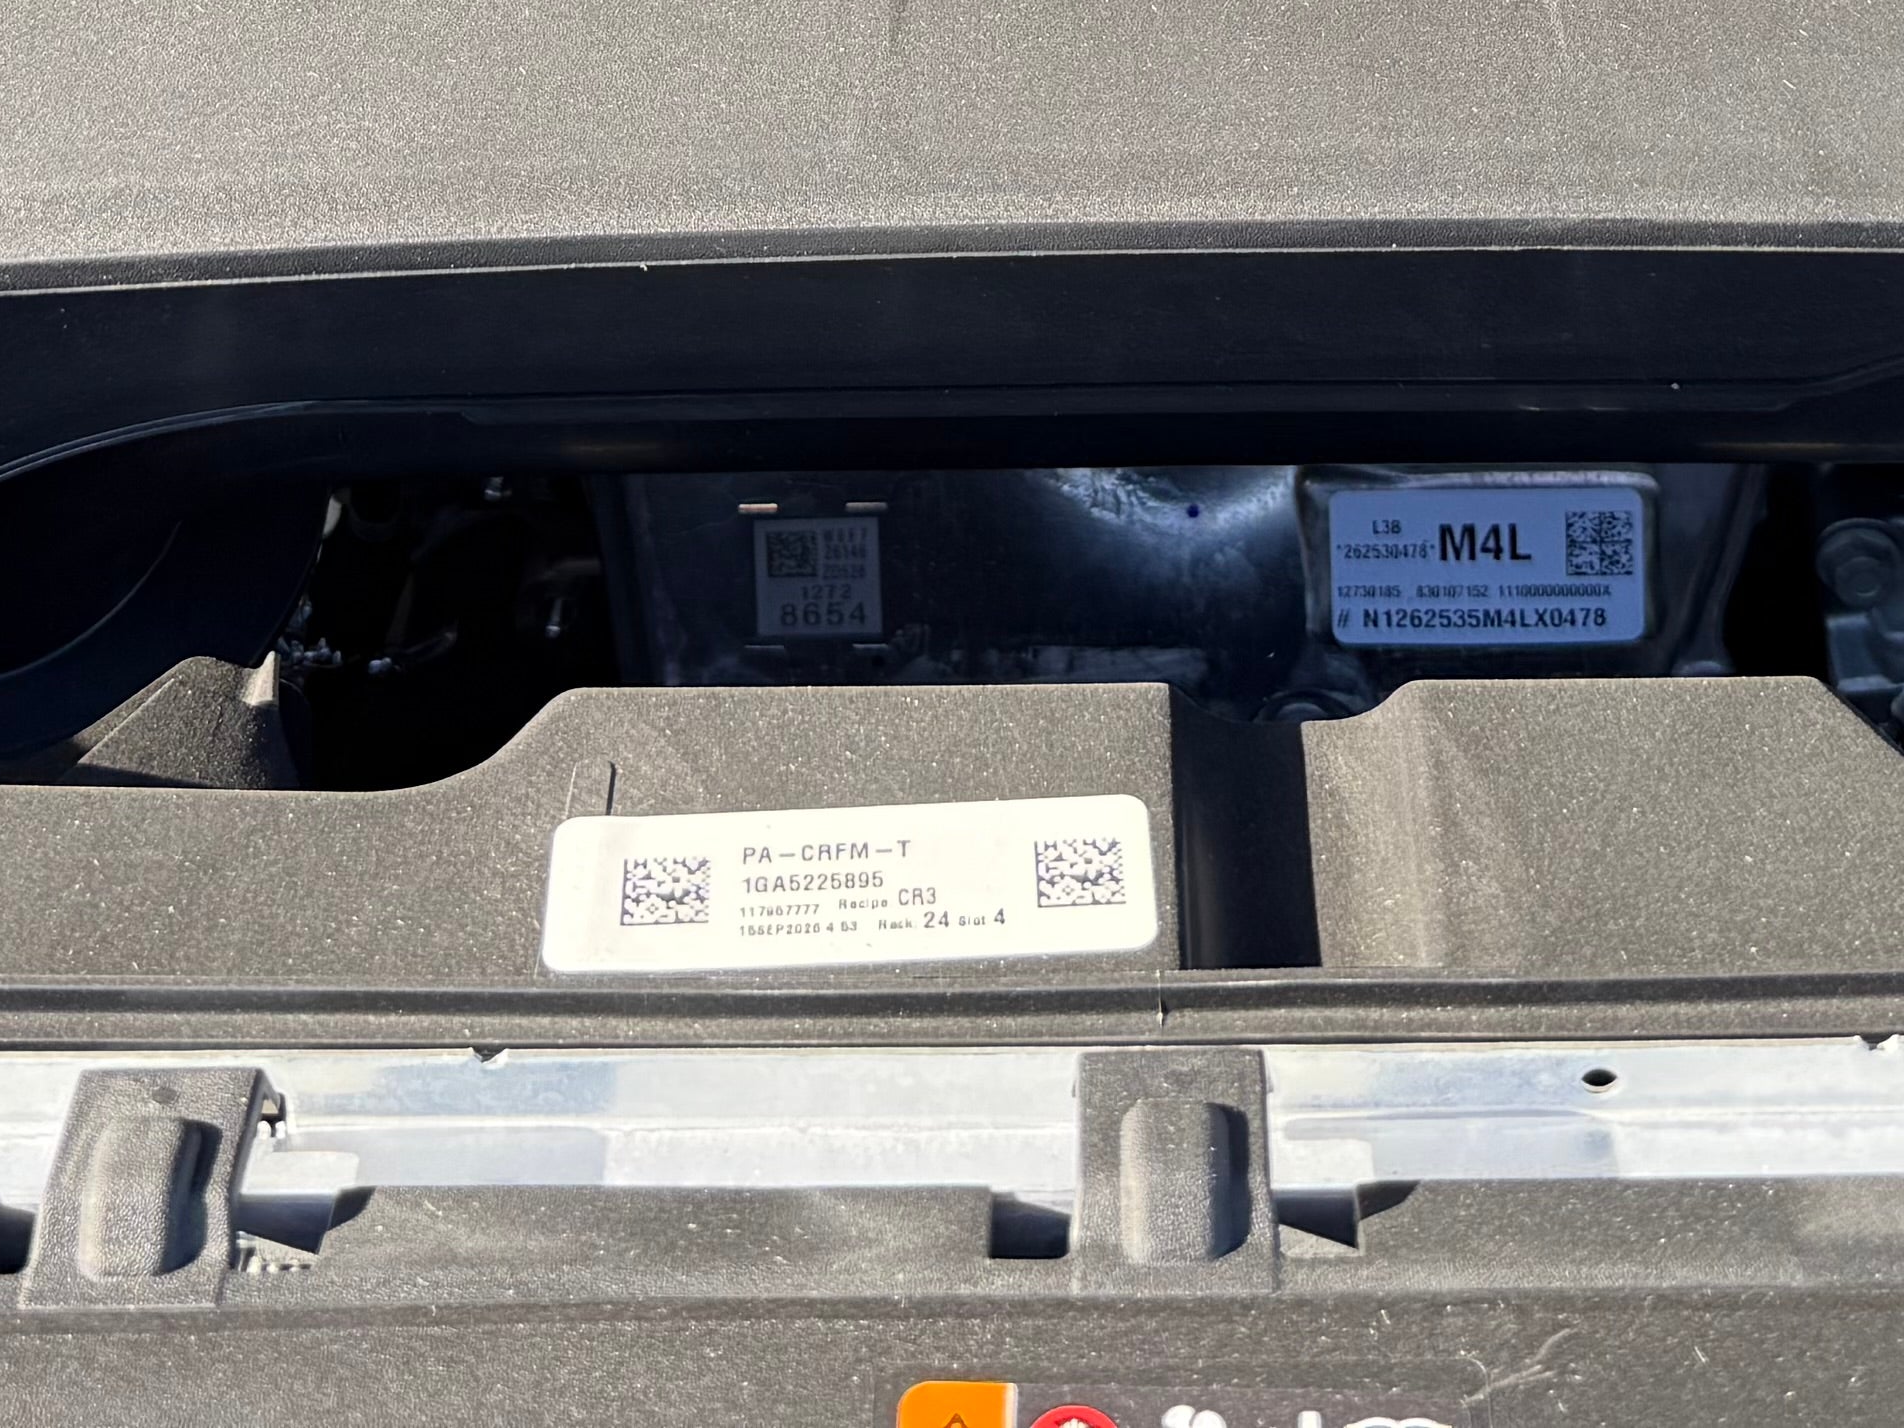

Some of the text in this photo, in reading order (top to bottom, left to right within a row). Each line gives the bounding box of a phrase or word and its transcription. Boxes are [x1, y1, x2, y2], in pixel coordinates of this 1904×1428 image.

[1439, 522, 1533, 563] M4L
[801, 584, 852, 601] 1272
[780, 601, 868, 627] 8654
[1362, 607, 1608, 629] N1262535M4LX0478
[897, 887, 937, 906] CR3
[923, 910, 950, 929] 24
[993, 907, 1006, 925] 4
